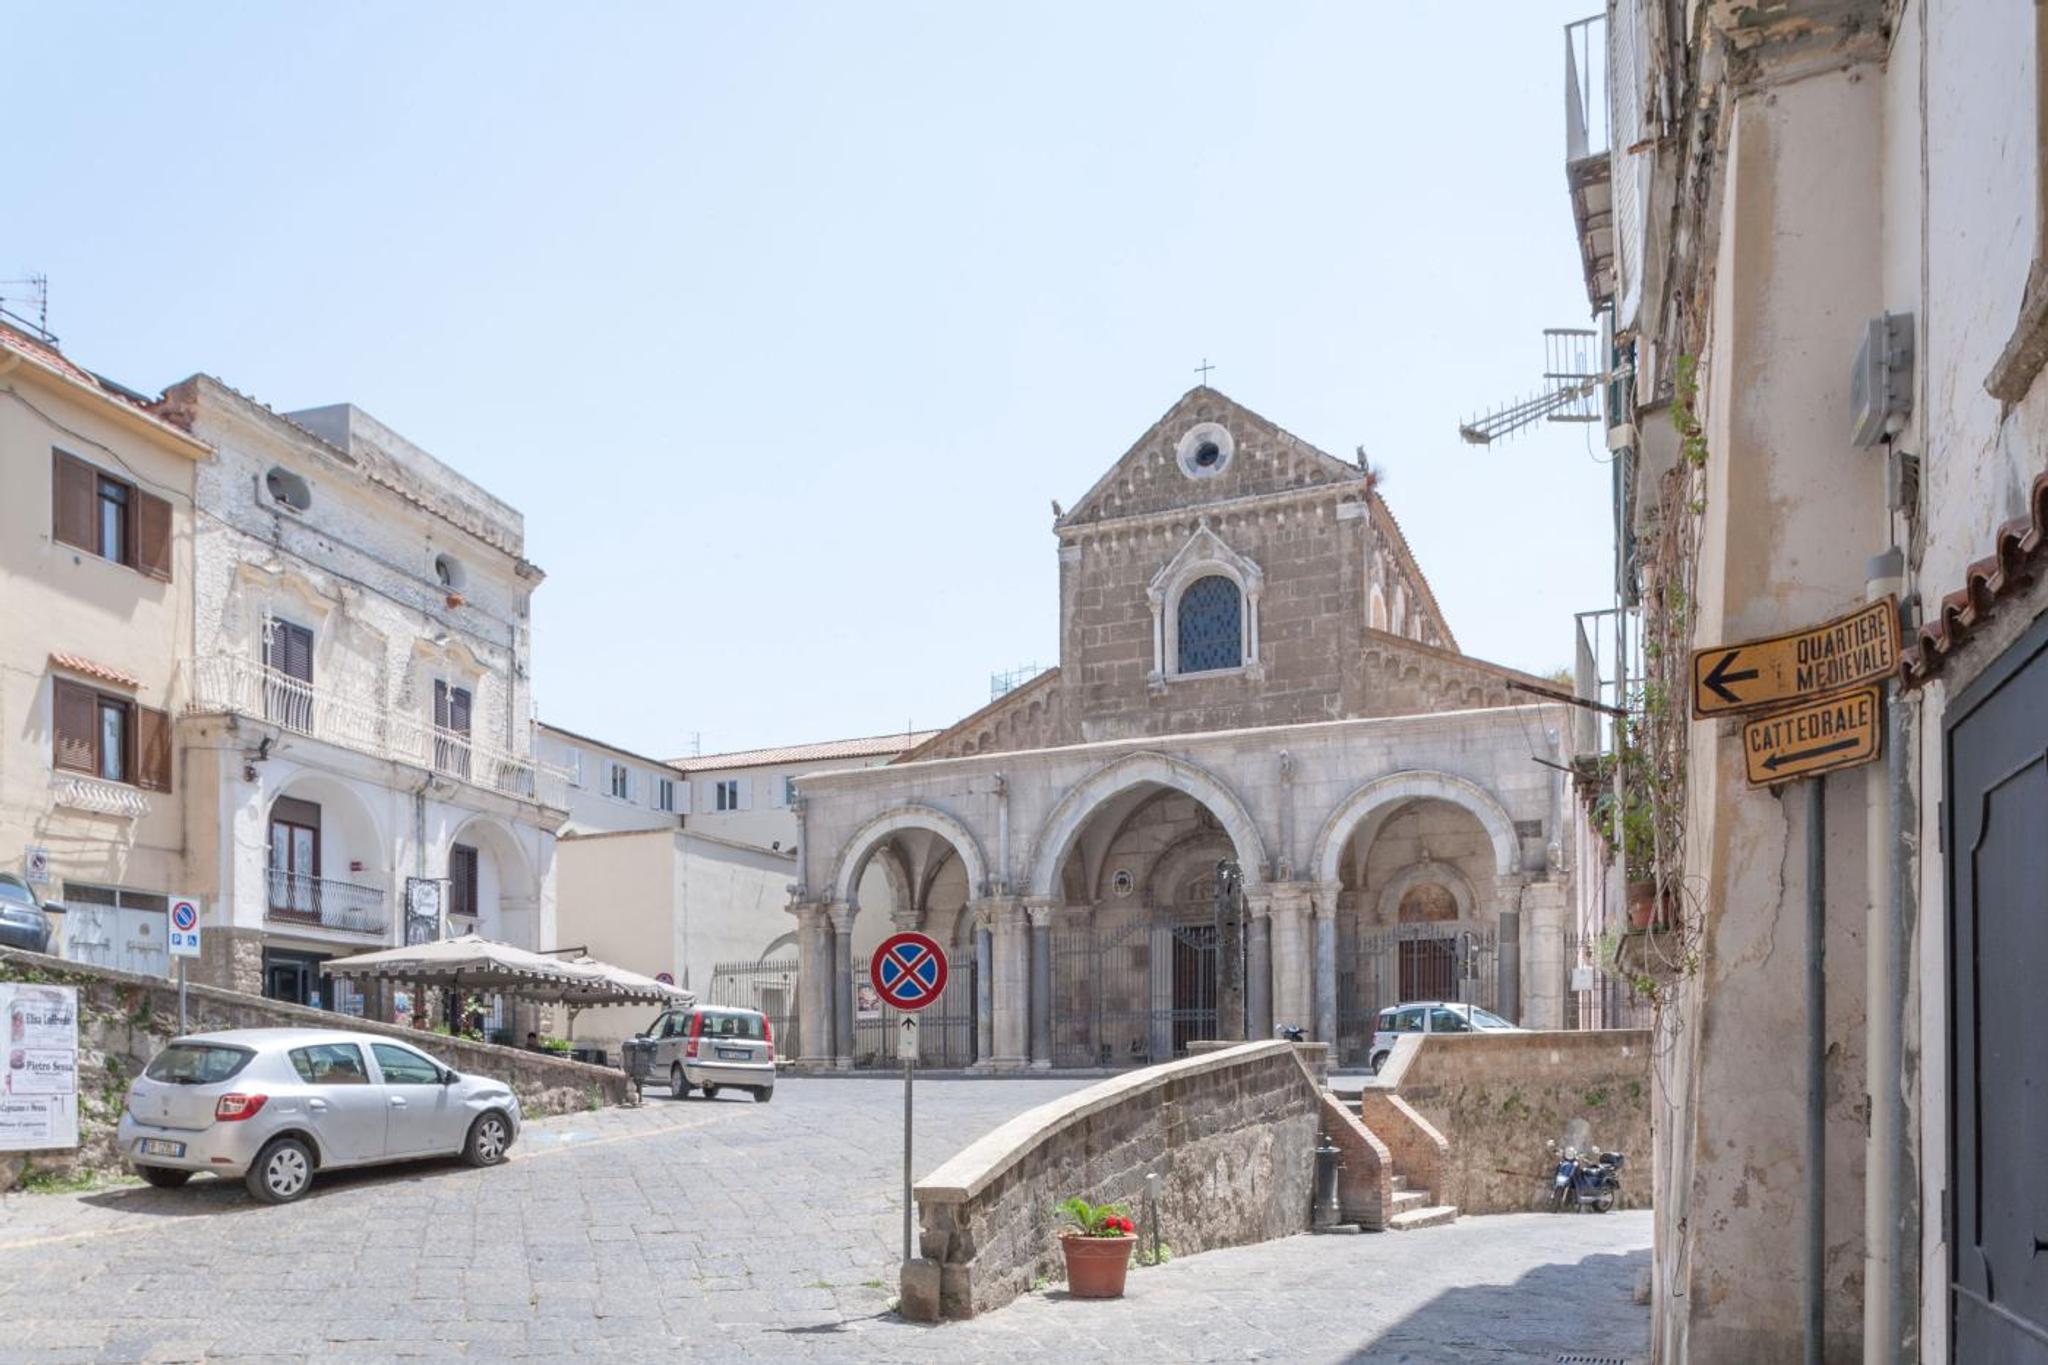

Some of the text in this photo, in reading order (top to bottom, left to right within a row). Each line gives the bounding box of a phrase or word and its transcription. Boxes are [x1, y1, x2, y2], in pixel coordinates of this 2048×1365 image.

[1797, 607, 1886, 664] QUARTIERE
[1797, 638, 1889, 692] MEDIEVALE
[1751, 700, 1868, 752] CATTEDRALE
[26, 1061, 51, 1071] Pietro
